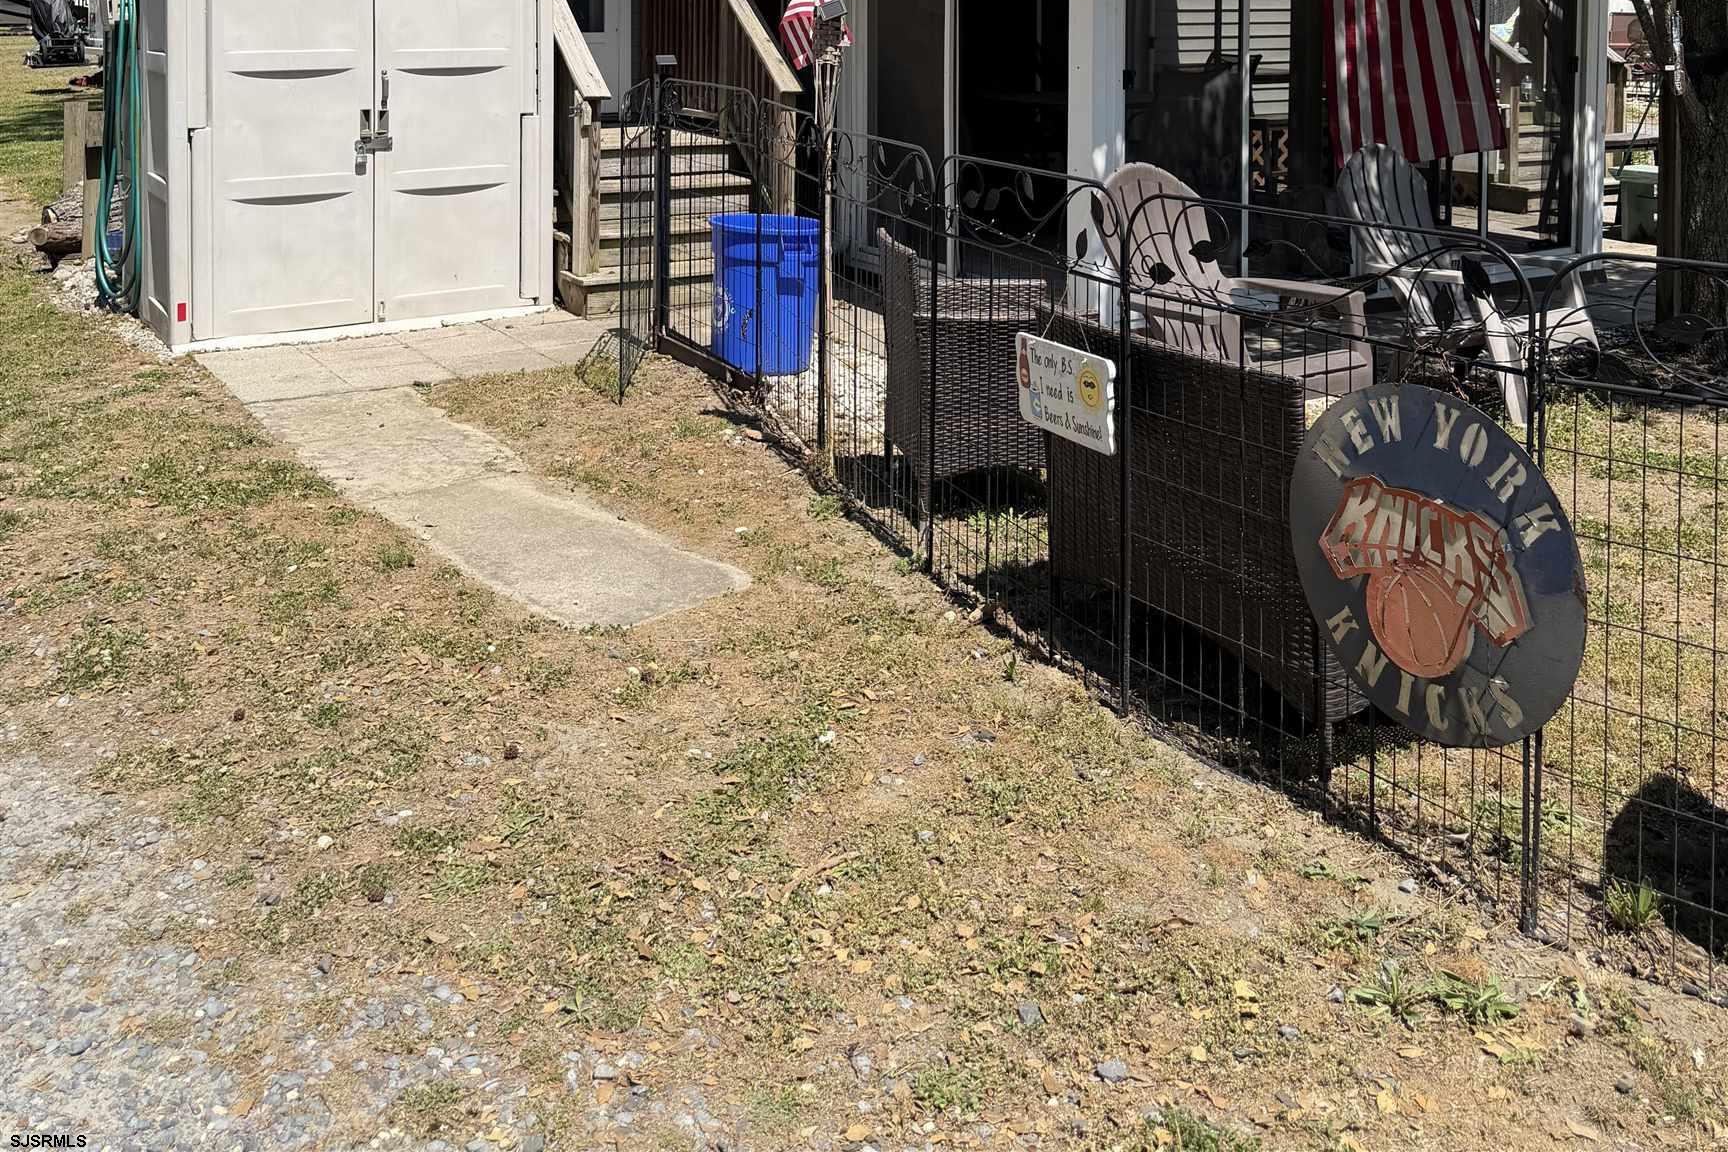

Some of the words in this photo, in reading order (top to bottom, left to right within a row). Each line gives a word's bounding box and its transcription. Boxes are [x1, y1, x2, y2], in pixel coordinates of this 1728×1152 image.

[1030, 347, 1042, 366] The
[1044, 353, 1058, 376] only
[1040, 376, 1044, 394] I
[1046, 383, 1063, 401] need
[1067, 387, 1074, 404] is
[1044, 406, 1063, 426] Beers
[1065, 412, 1072, 430] &
[1312, 394, 1402, 478] NEW
[1433, 401, 1561, 550] YORK
[1326, 483, 1529, 640] KNICKS
[1325, 605, 1524, 736] KNICKS
